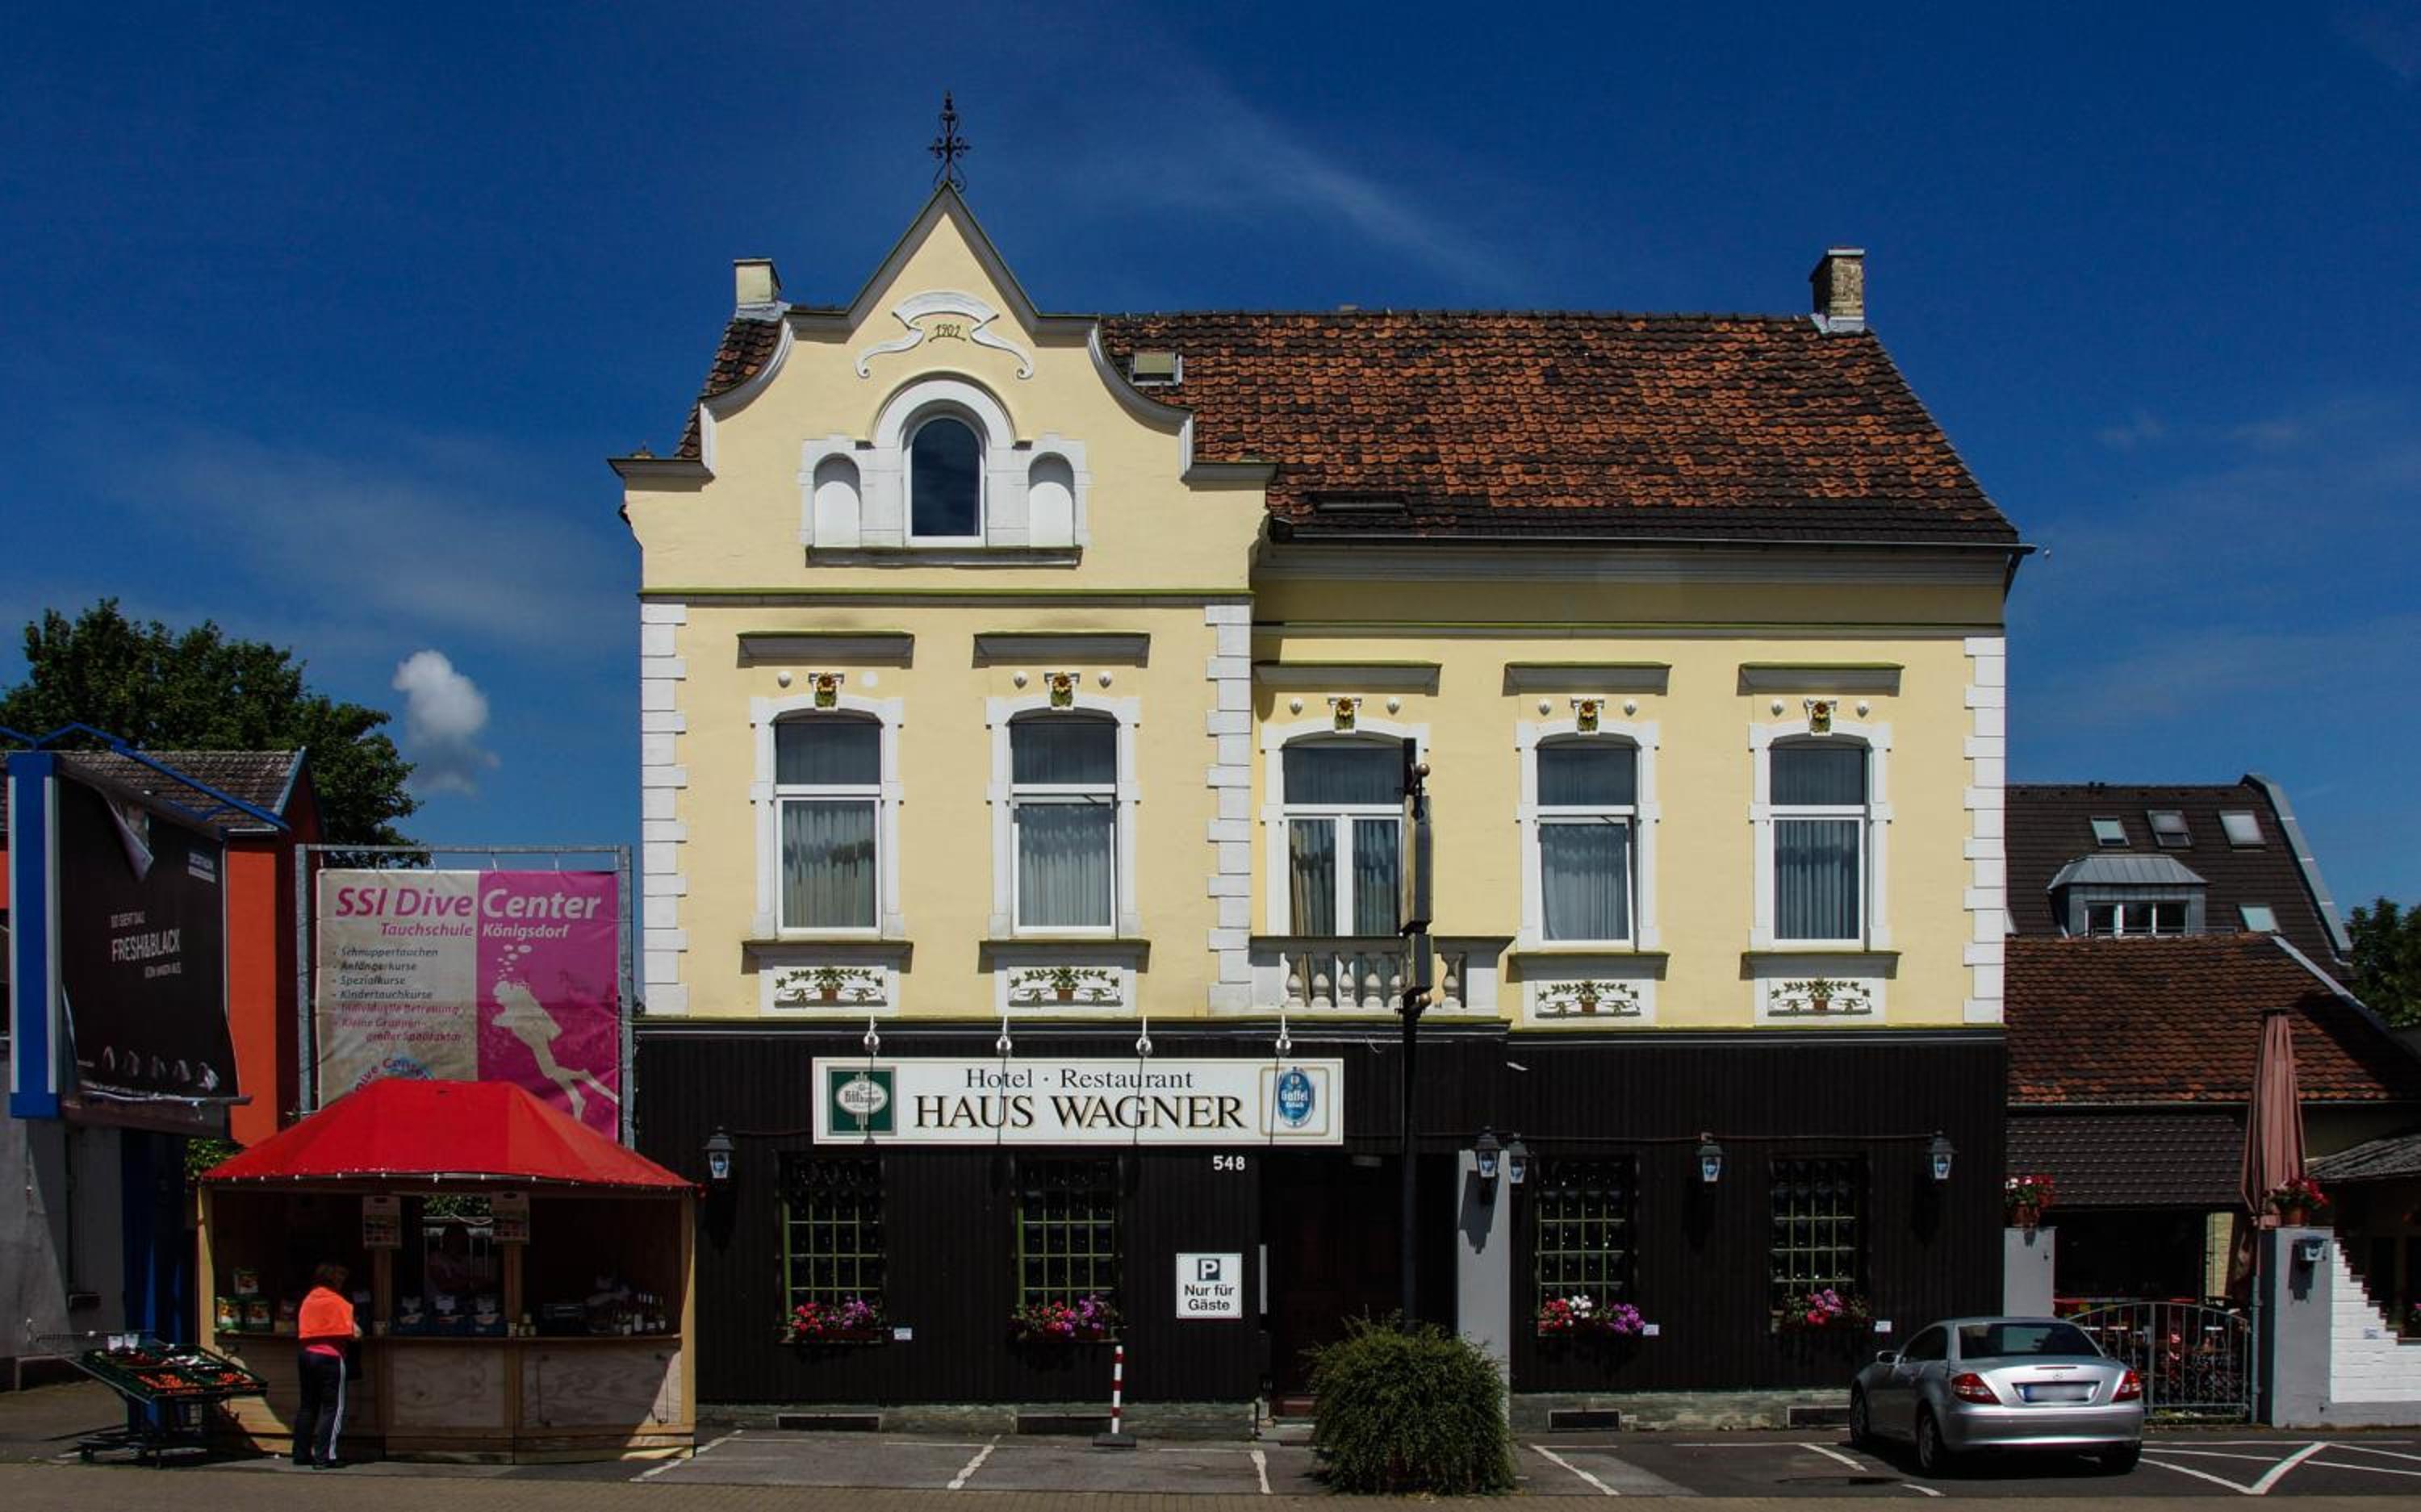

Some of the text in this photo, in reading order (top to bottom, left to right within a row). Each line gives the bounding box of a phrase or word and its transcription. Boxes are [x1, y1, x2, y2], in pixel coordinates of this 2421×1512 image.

[335, 888, 601, 920] SSI Dive Center
[380, 921, 571, 942] Tauchschule Königsdorf
[966, 1068, 1194, 1088] Hotel Restaurant
[1281, 1089, 1309, 1101] Gaffel
[915, 1095, 1248, 1129] HAUS WAGNER
[1213, 1155, 1245, 1171] 548
[1201, 1259, 1218, 1280] P
[1185, 1284, 1235, 1296] Nur für
[1188, 1298, 1230, 1311] Gäste
